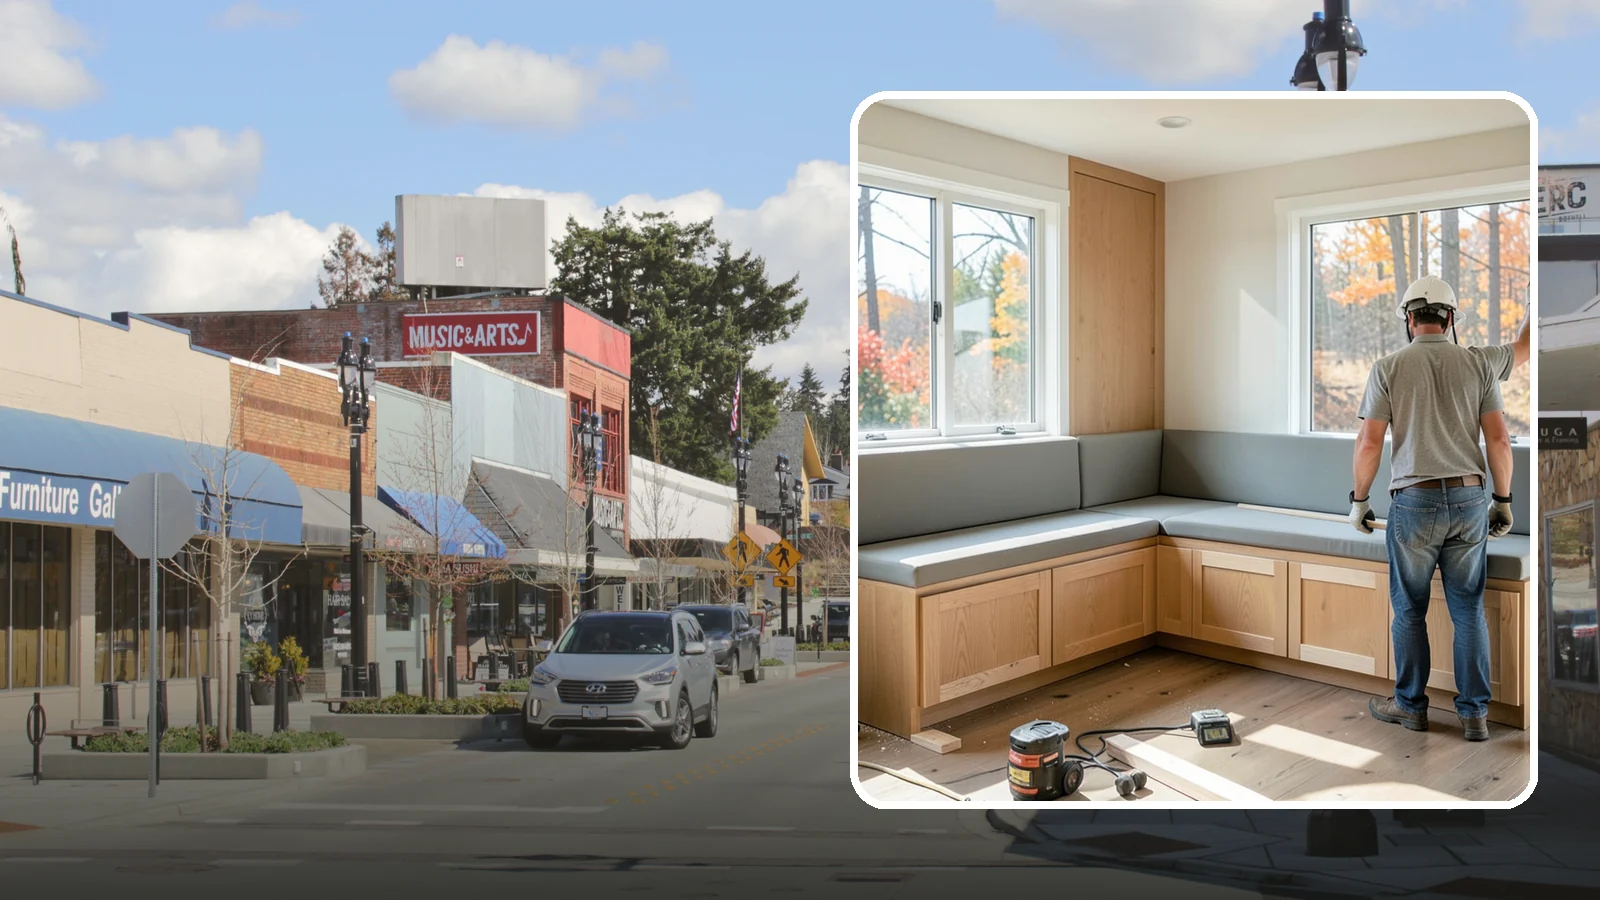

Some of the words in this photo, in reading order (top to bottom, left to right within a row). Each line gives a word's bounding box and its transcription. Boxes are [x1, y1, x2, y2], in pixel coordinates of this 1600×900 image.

[409, 323, 519, 348] MUSIC&ARTS
[1540, 428, 1577, 436] UGA
[0, 471, 79, 515] Furniture
[89, 482, 121, 519] Gal
[454, 563, 479, 574] SUSHI
